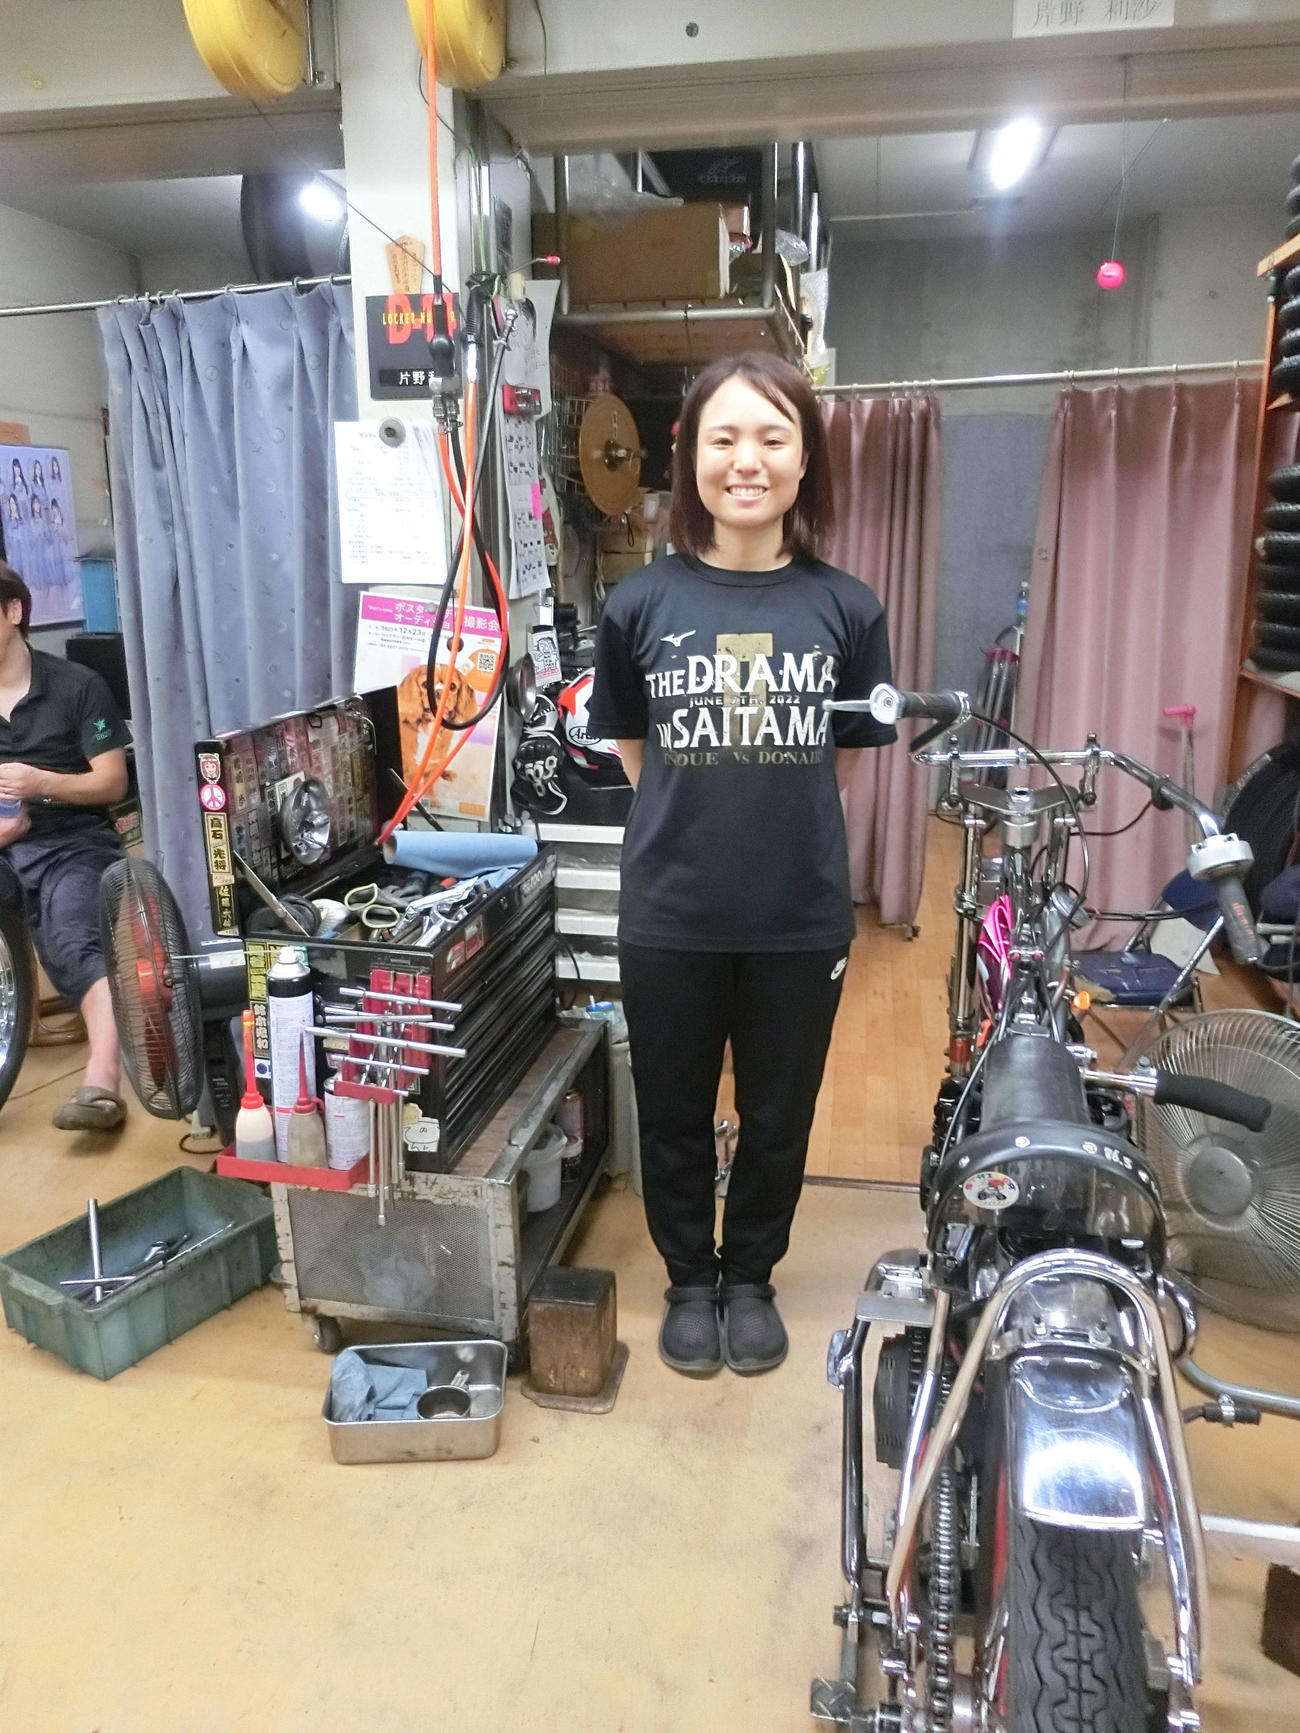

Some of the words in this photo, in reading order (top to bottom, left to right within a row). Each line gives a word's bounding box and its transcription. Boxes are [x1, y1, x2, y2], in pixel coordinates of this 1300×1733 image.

[382, 311, 416, 326] LOCKER
[398, 370, 438, 386] 片野
[464, 616, 499, 632] 撮影会
[645, 669, 686, 698] THE
[686, 652, 836, 695] DRAMA
[689, 695, 723, 708] JUNE
[769, 695, 800, 705] 2022
[656, 722, 672, 750] IN
[672, 706, 831, 750] SAITAMA
